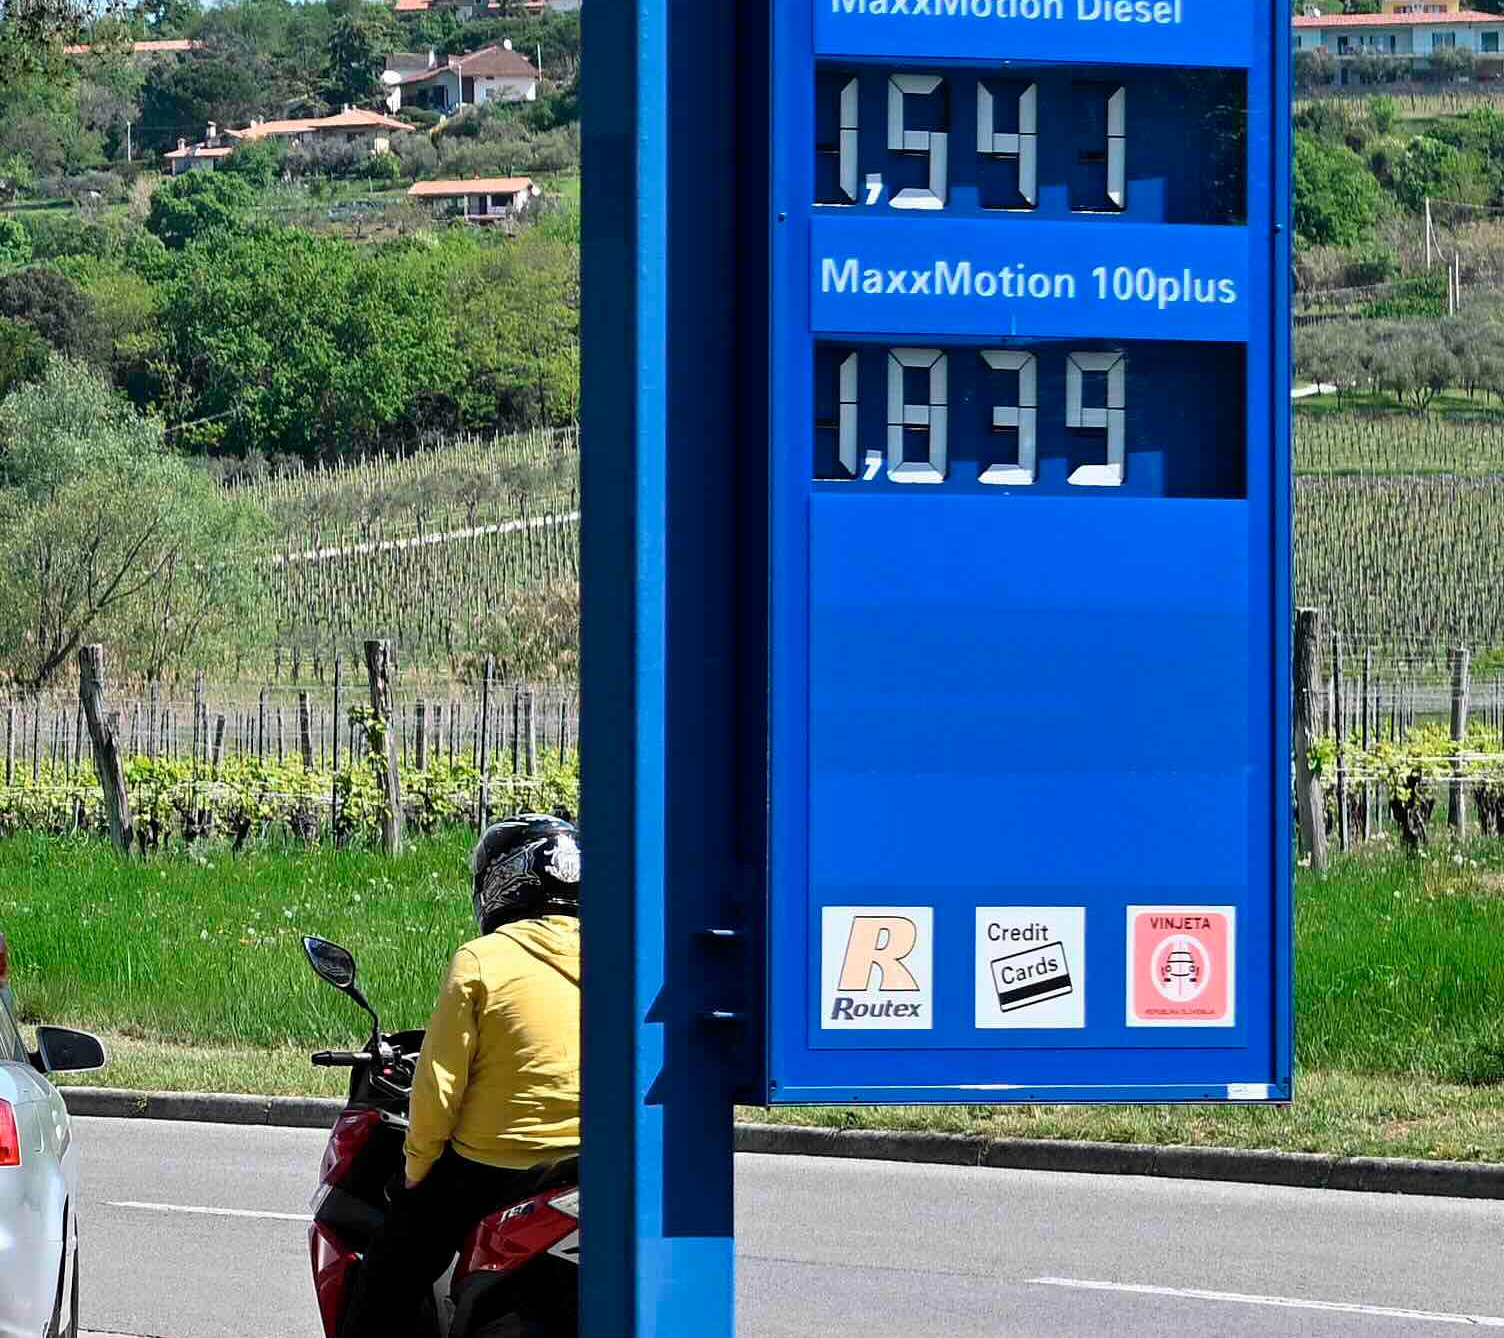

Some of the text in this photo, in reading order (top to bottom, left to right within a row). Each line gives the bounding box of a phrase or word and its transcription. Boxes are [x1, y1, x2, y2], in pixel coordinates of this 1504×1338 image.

[839, 74, 1126, 211] 1,541
[821, 258, 1237, 310] MaxxMotion 100plus
[839, 348, 1126, 487] 1,839
[987, 922, 1049, 941] Credit
[1150, 917, 1211, 930] VINJETA
[837, 915, 920, 992] R
[1001, 957, 1058, 984] Cards
[831, 997, 923, 1021] Routex
